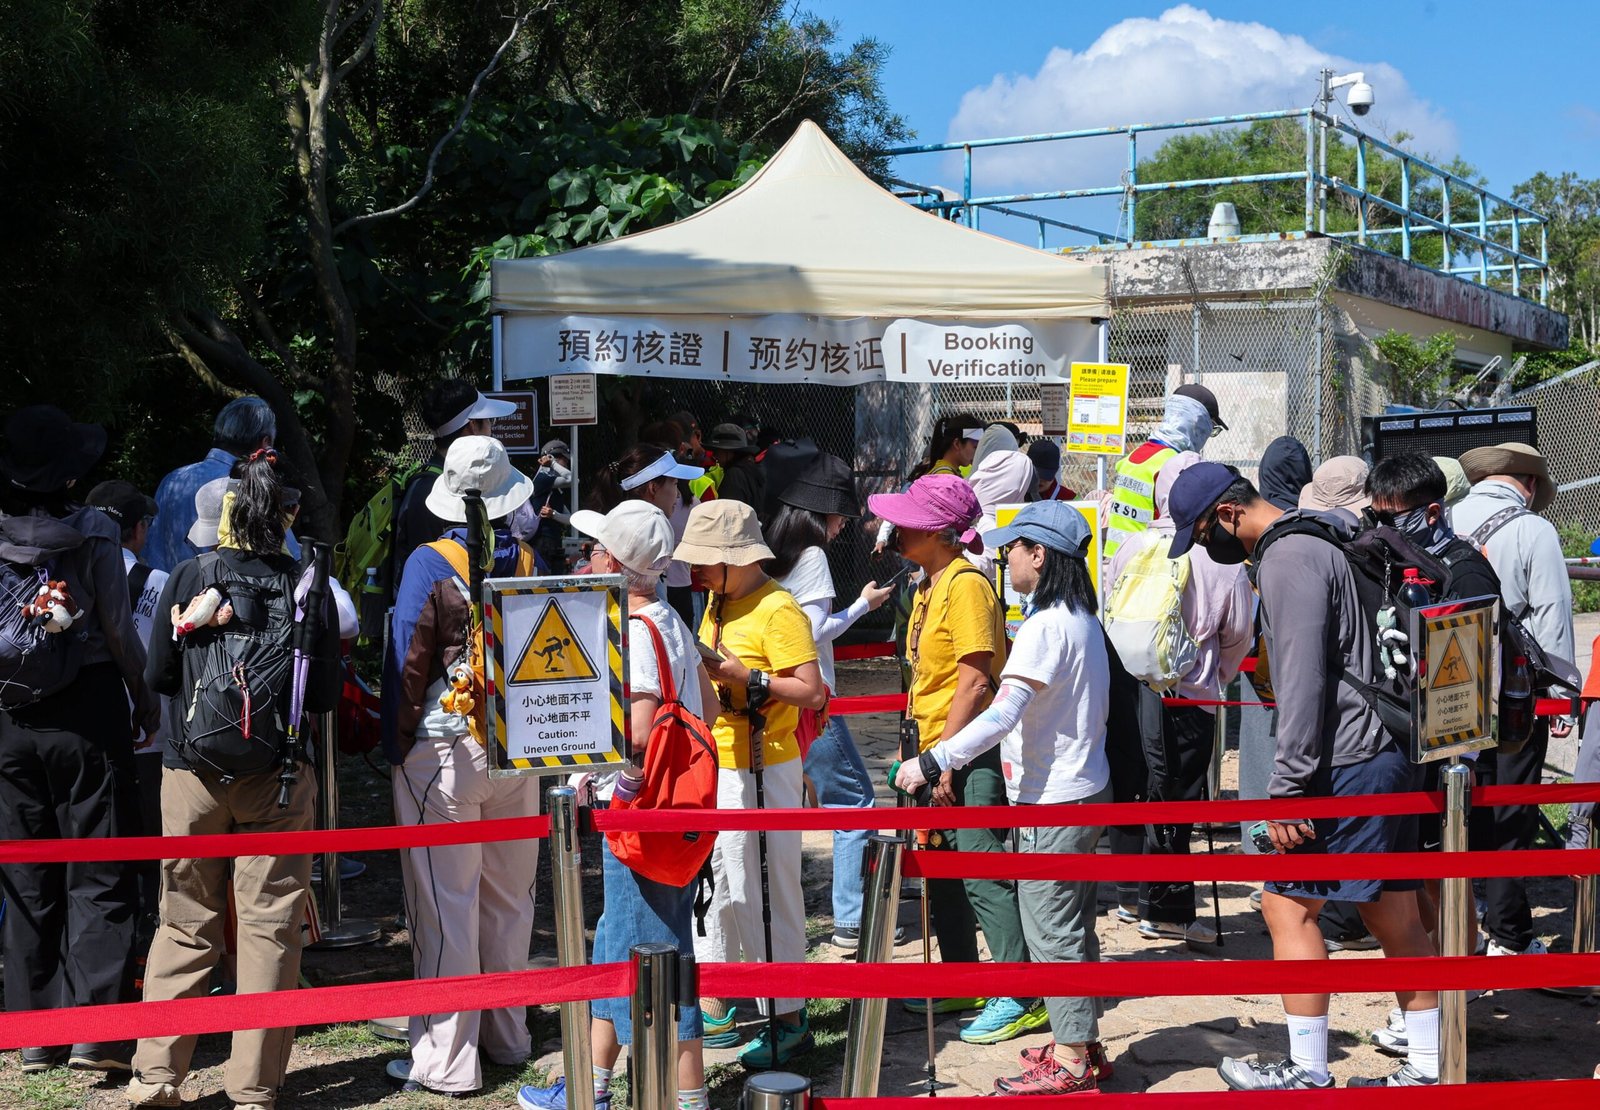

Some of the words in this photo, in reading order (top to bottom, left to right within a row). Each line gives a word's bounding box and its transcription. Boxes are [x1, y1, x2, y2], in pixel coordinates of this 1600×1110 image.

[944, 333, 1034, 354] Booking
[558, 330, 702, 366] 預約核證
[749, 337, 884, 374] 预约核证
[928, 359, 1046, 377] Verification
[522, 691, 593, 708] 小心地面不平
[1436, 690, 1470, 704] 小心地面不平
[526, 710, 591, 725] 小心地面不平
[538, 730, 578, 740] Caution:
[1453, 723, 1471, 732] Ground
[523, 744, 559, 754] Uneven
[561, 741, 596, 751] Ground
